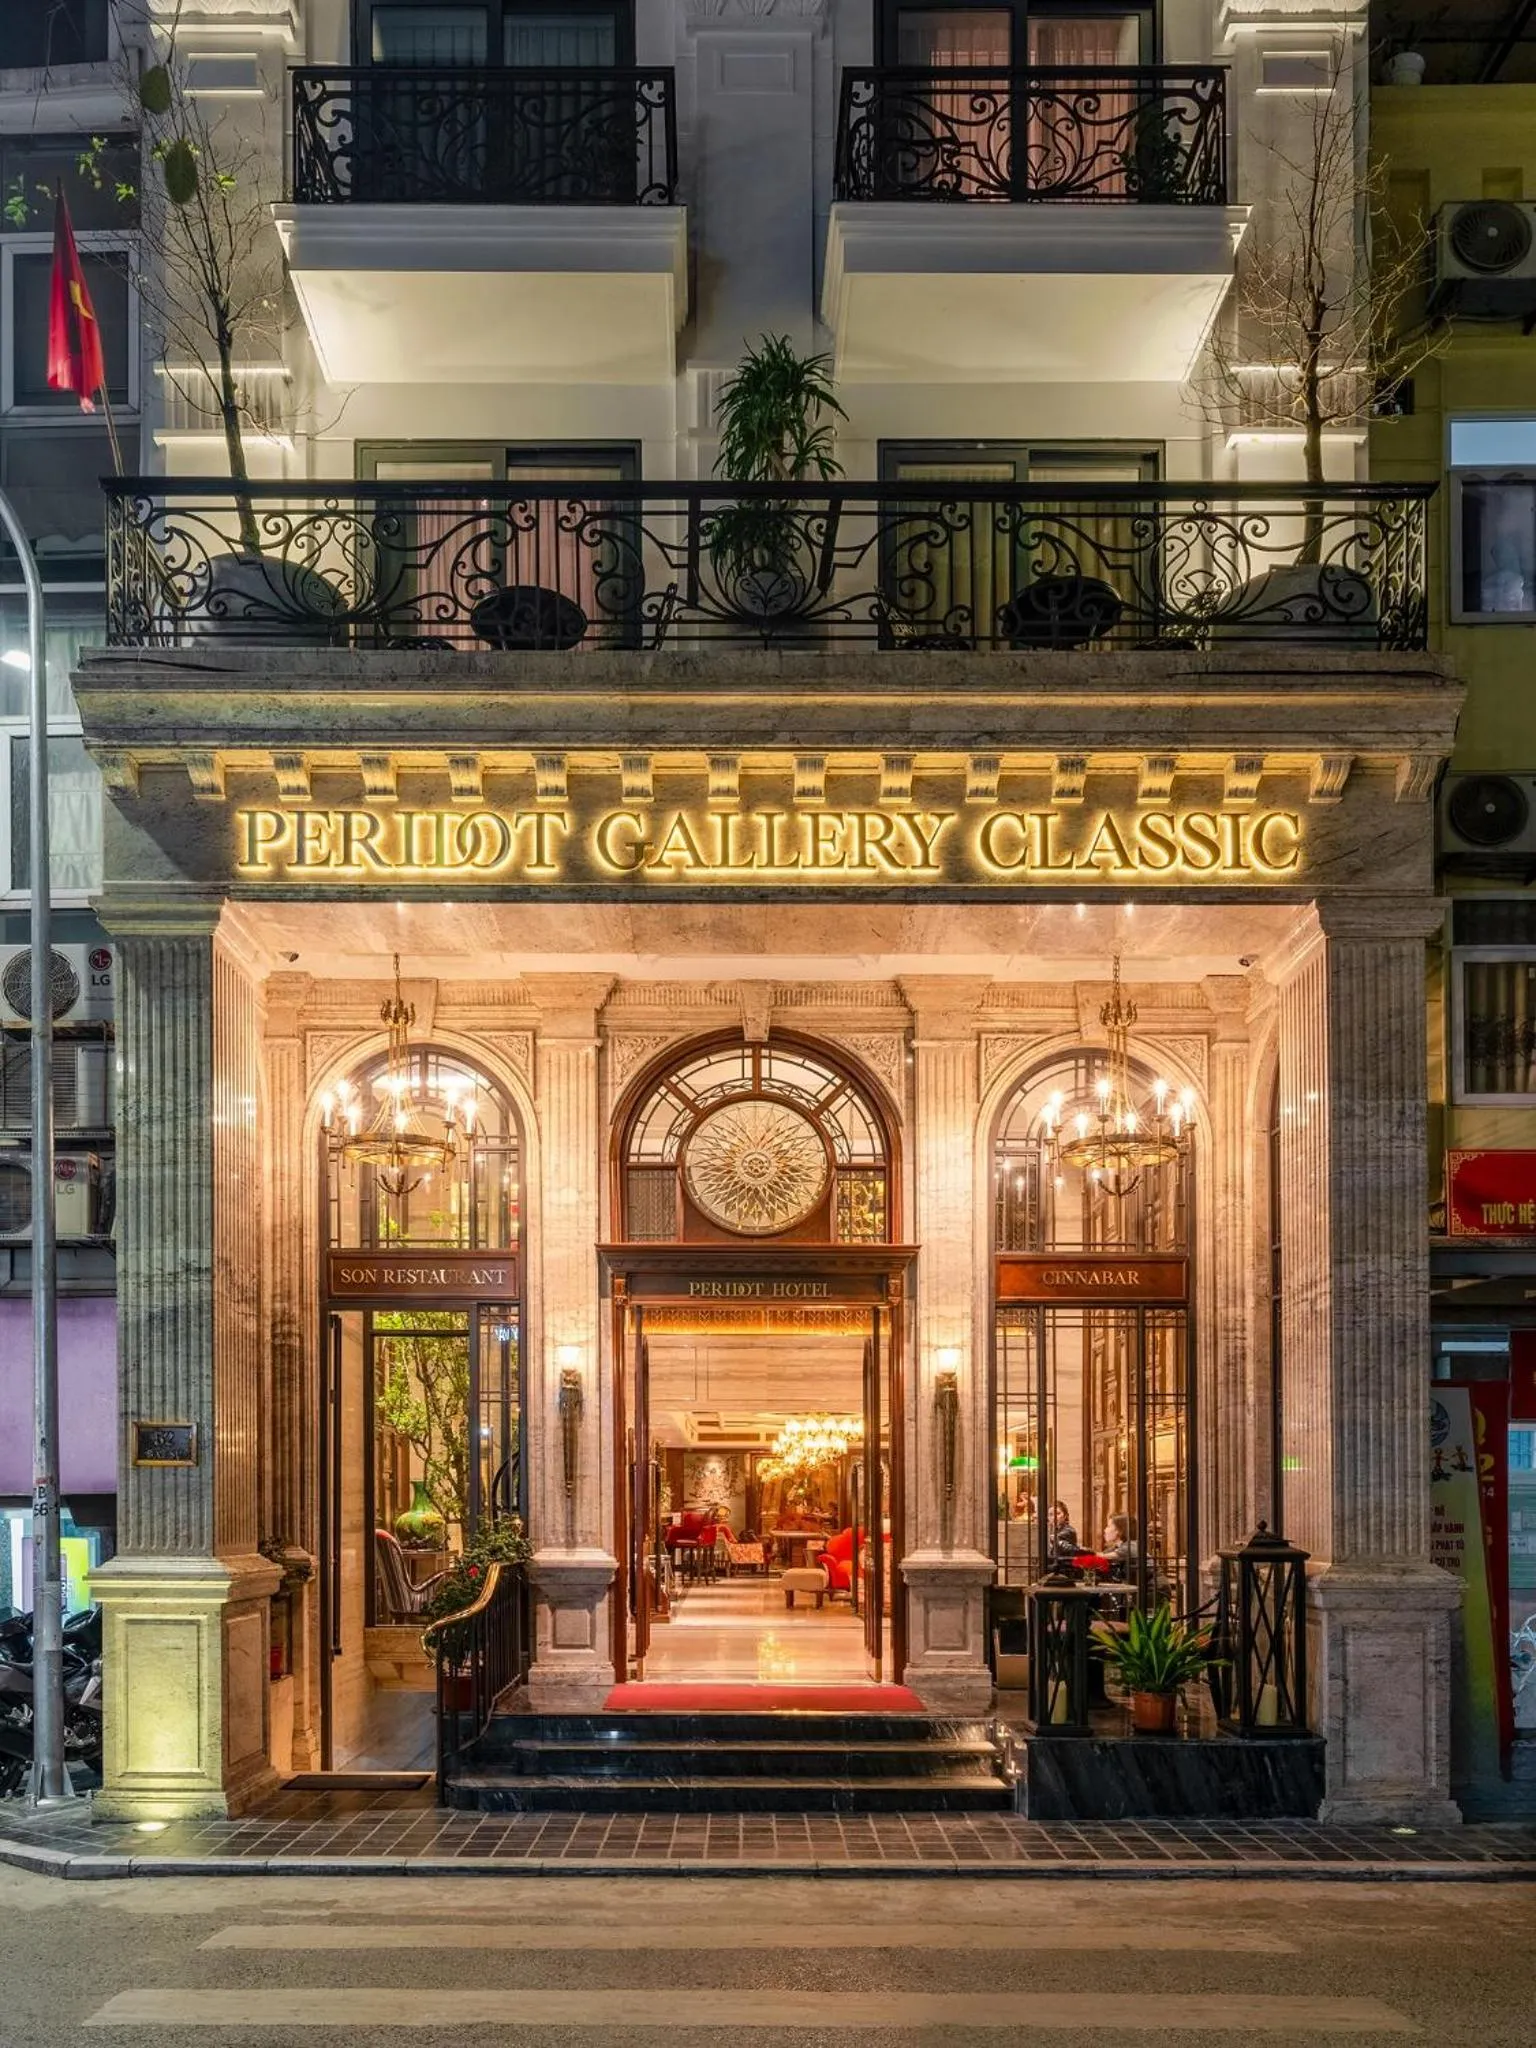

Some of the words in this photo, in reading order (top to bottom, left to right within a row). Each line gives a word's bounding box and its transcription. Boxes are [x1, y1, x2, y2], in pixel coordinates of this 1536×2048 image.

[237, 809, 567, 869] PERIDOT
[596, 811, 955, 871] GALLERY
[979, 811, 1300, 871] CLASSIC
[92, 975, 110, 986] LG
[56, 1184, 75, 1195] LG
[340, 1269, 376, 1283] SON
[384, 1269, 506, 1284] RESTAURANT
[1042, 1270, 1140, 1285] CINNABAR
[689, 1281, 764, 1297] PERIDOT
[773, 1282, 833, 1297] HOTEL
